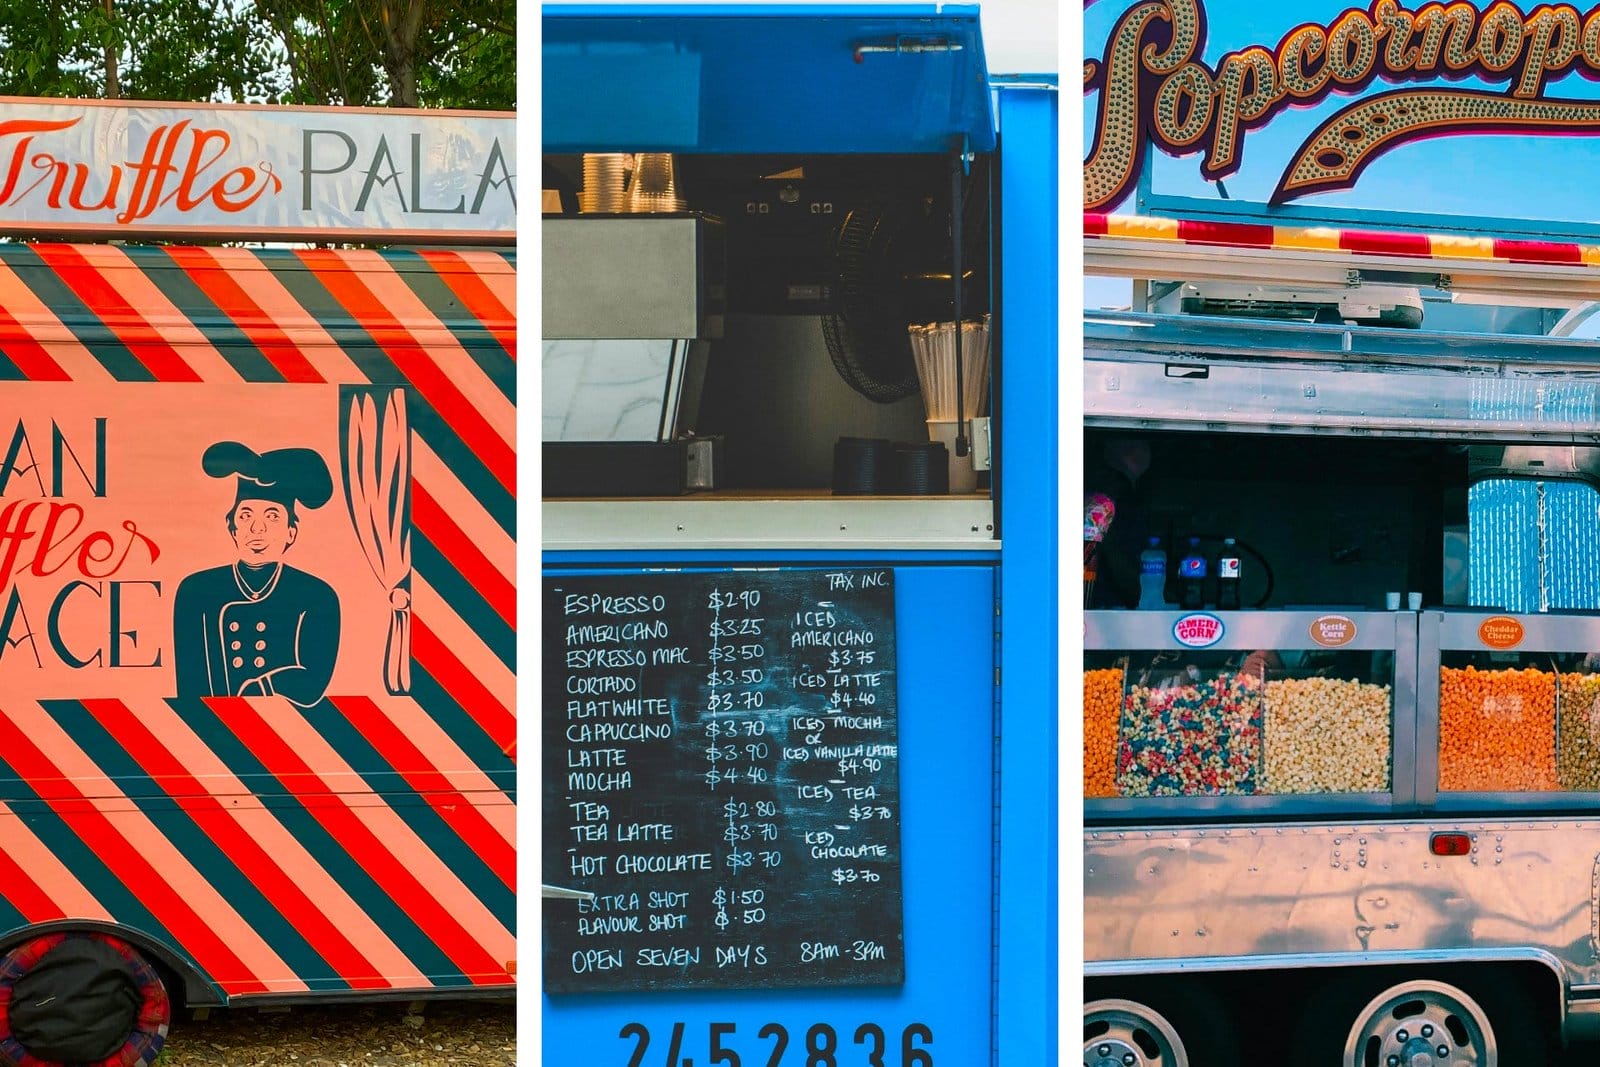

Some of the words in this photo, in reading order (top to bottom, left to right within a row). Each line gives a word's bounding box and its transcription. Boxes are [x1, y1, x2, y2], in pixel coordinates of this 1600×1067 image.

[300, 129, 517, 214] PALA
[0, 417, 108, 498] AN
[825, 573, 854, 592] TAX
[862, 571, 890, 589] INC.
[564, 594, 665, 615] ESPRESSO
[708, 588, 761, 616] $2.90
[0, 580, 162, 669] ACE
[796, 612, 836, 628] ICED
[1178, 619, 1219, 630] AMERI
[566, 620, 669, 646] AMERICANO
[709, 618, 765, 640] $3.25
[791, 631, 874, 648] AMERICANO
[1180, 628, 1216, 640] CORN
[1322, 631, 1345, 639] Corn
[566, 650, 646, 668] ESPRESSO
[653, 647, 690, 666] MAC
[708, 645, 765, 664] $3.50
[828, 649, 876, 667] $3.75
[566, 676, 636, 696] CORTADO
[708, 669, 764, 690] $3.50
[792, 675, 826, 688] ICED
[833, 673, 881, 688] LATTE
[708, 690, 764, 716] $3.70
[830, 690, 876, 708] $4.40
[566, 723, 671, 742] CAPPUCCINO
[705, 720, 765, 742] $3.70
[793, 717, 825, 731] ICED
[834, 717, 882, 729] MOCHA
[568, 749, 627, 768] LATTE
[705, 742, 768, 766] $3.90
[783, 747, 809, 761] ICED
[814, 745, 864, 759] VANILLA
[866, 745, 898, 757] LATTE
[568, 771, 632, 791] MOCHA
[705, 765, 768, 791] $4.40
[838, 759, 881, 777] $4.90
[799, 786, 833, 802] ICED
[842, 786, 876, 800] TEA
[570, 802, 610, 822] TEA
[724, 796, 776, 823] $2.80
[570, 825, 608, 842] TEA
[618, 824, 673, 842] LATTE
[724, 823, 778, 847] $3.70
[571, 856, 607, 876] HOT
[616, 854, 713, 874] CHOCOLATE
[726, 847, 782, 876] $3.70
[811, 845, 887, 859] CHOCOLATE
[832, 868, 880, 885] $3.70
[579, 893, 640, 914] EXTRA
[648, 892, 690, 909] SHOT
[712, 887, 765, 909] $1.50
[578, 918, 643, 936] FLAVOUR
[649, 915, 687, 932] SHOT
[572, 948, 623, 974] OPEN
[637, 946, 700, 967] SEVEN
[716, 944, 768, 969] DAYS
[619, 1022, 934, 1067] 2452836
